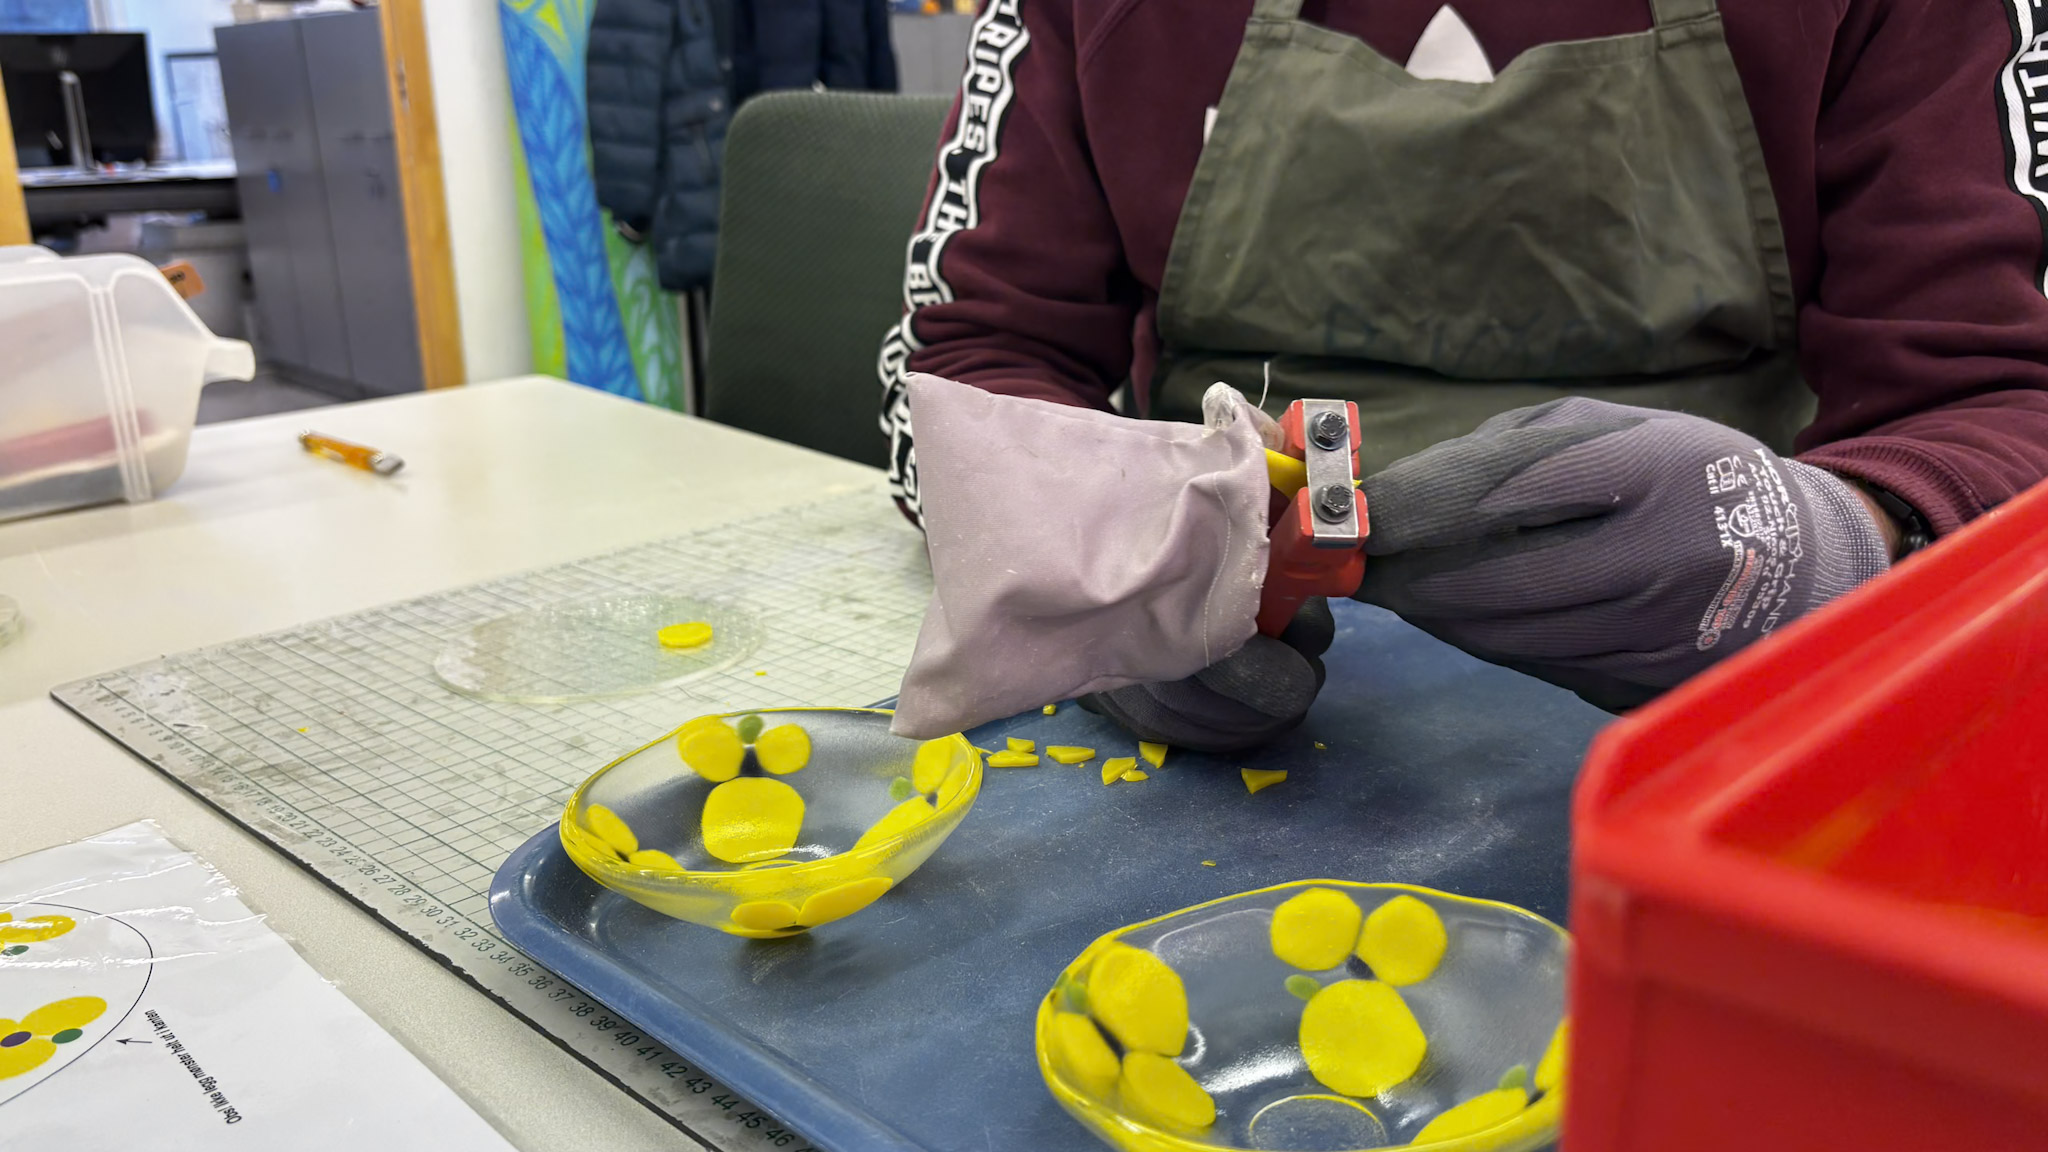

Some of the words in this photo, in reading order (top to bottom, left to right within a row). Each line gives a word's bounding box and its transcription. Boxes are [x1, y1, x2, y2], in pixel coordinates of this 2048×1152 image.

[1705, 463, 1718, 485] Cat
[1760, 466, 1785, 532] Touch
[1714, 506, 1734, 548] 4131X
[1761, 562, 1784, 610] Grip
[289, 820, 311, 830] 21
[303, 829, 324, 839] 22
[316, 837, 337, 848] 23
[329, 846, 352, 857] 24
[358, 864, 381, 876] 26
[372, 874, 396, 885] 27
[387, 884, 411, 896] 28
[403, 894, 427, 906] 29
[420, 905, 444, 917] 30
[436, 916, 461, 928] 31
[454, 927, 478, 940] 32
[471, 939, 496, 952] 33
[490, 950, 515, 964] 34
[508, 962, 534, 977] 35
[528, 975, 553, 990] 36
[548, 988, 577, 1002] 37
[569, 1001, 595, 1017] 38
[590, 1015, 620, 1031] 39
[614, 1031, 640, 1047] 40
[637, 1046, 663, 1062] 41
[660, 1061, 688, 1079] 42
[685, 1077, 713, 1095] 43
[711, 1094, 739, 1111] 44
[737, 1111, 769, 1129] 45
[765, 1128, 796, 1147] 46
[145, 1009, 168, 1032] kanten
[160, 1032, 176, 1042] ut
[165, 1040, 186, 1055] helt
[198, 1076, 218, 1095] legg
[217, 1105, 242, 1124] Obs!
